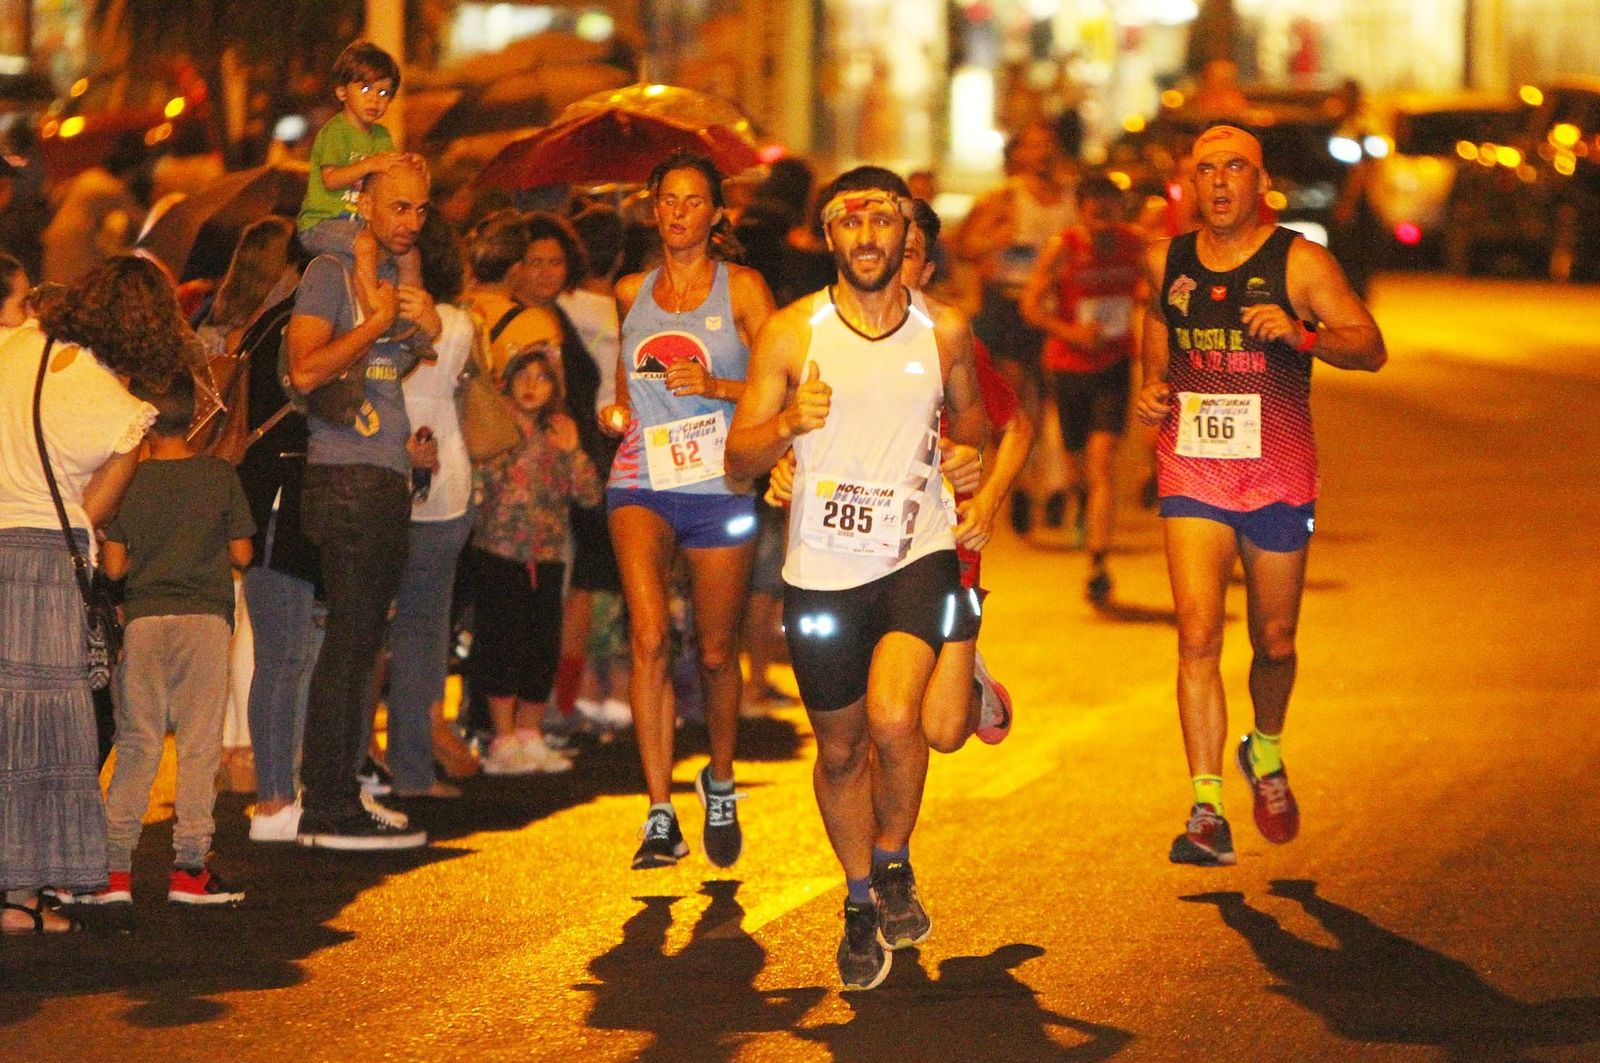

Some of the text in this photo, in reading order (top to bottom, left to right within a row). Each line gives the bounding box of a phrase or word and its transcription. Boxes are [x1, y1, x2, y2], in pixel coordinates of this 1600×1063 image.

[1193, 328, 1226, 351] COSTA
[1201, 398, 1251, 407] NOCTURNA
[1194, 415, 1235, 439] 166
[671, 439, 702, 467] 62
[833, 492, 892, 508] DE HUELVA
[836, 483, 895, 498] NOCTURNA
[823, 501, 873, 534] 285
